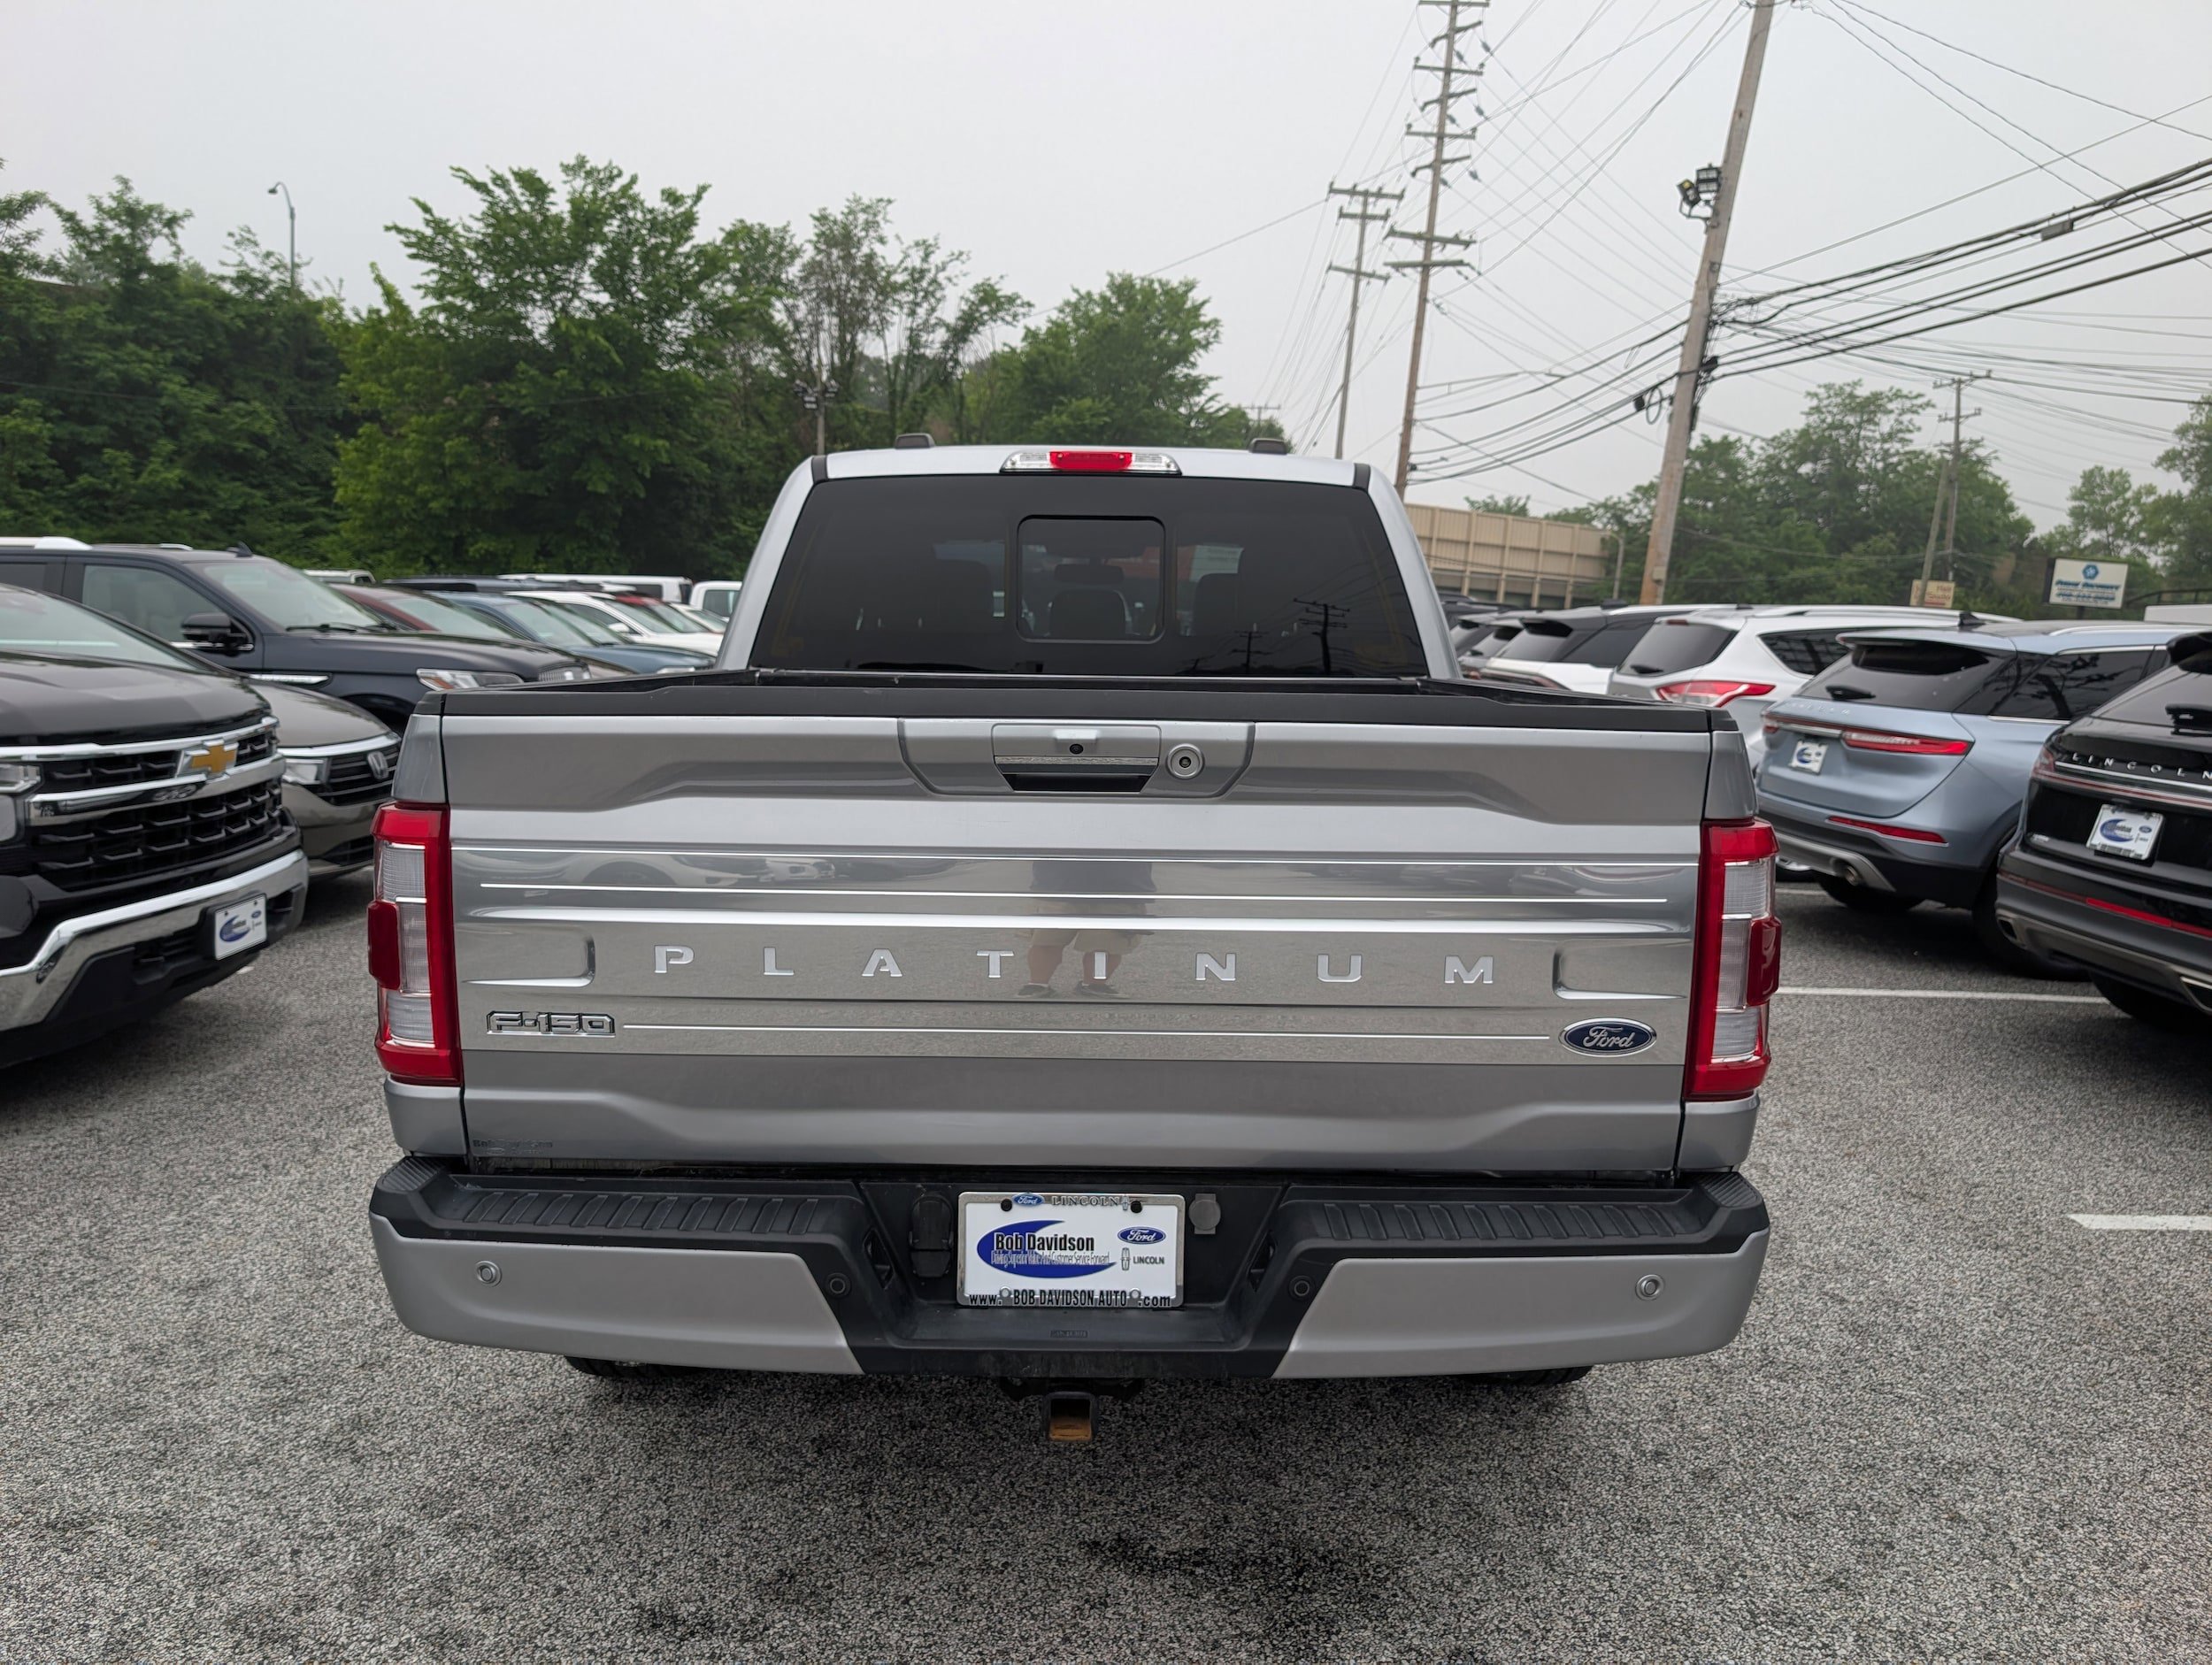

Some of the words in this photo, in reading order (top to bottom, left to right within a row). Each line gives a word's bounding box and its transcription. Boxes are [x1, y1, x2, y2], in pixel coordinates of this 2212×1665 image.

[2071, 752, 2212, 780] LINCOLN
[654, 944, 1494, 985] PLATINUM
[487, 1010, 616, 1038] F-150
[1582, 1026, 1635, 1047] Ford
[1051, 1195, 1120, 1207] LINCOLN
[995, 1232, 1024, 1251] Bob
[1025, 1232, 1094, 1252] Davidson
[1133, 1255, 1165, 1265] LINCOLN
[1040, 1289, 1094, 1307] DAVIDSON
[1098, 1289, 1127, 1308] AUTO
